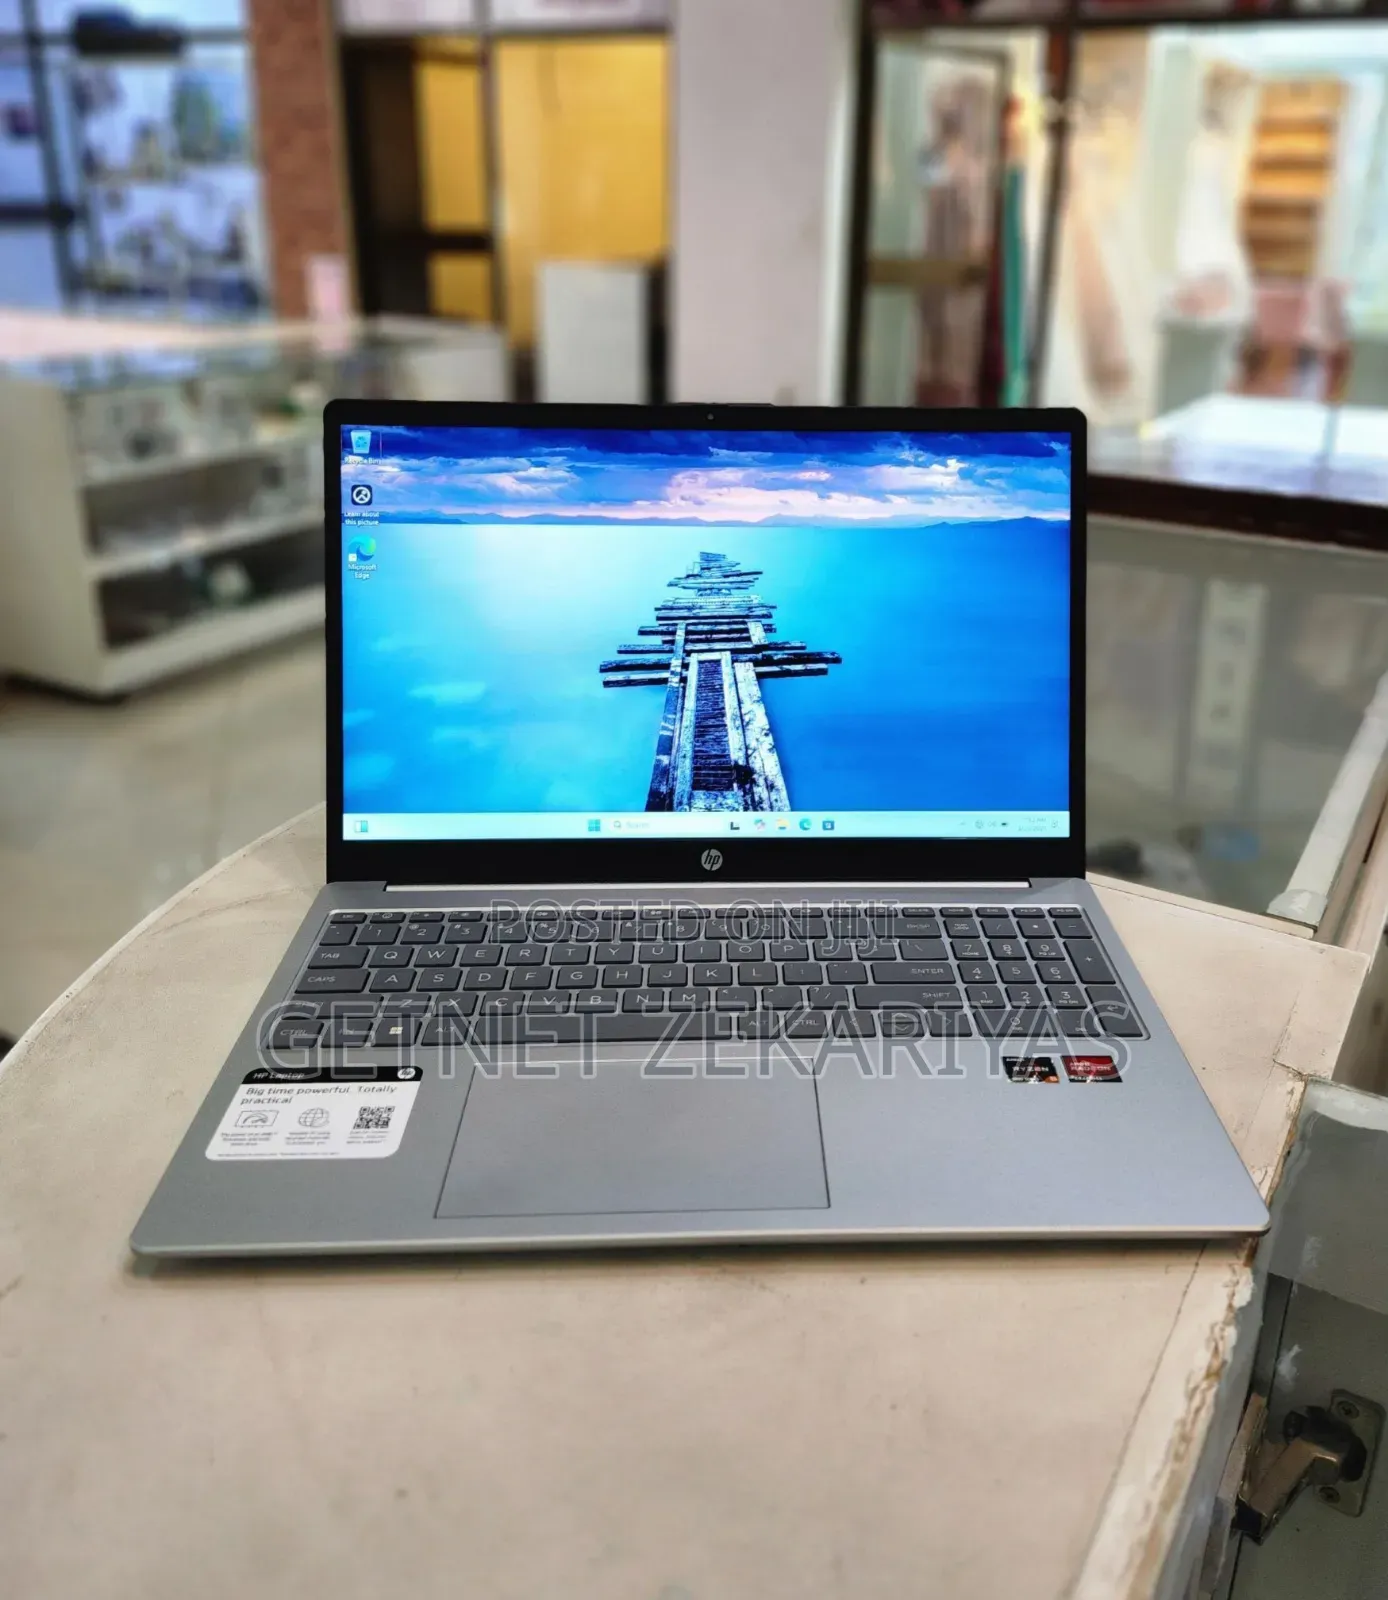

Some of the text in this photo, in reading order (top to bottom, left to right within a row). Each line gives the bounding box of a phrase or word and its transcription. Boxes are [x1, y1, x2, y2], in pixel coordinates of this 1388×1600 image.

[358, 519, 379, 527] picture
[348, 563, 377, 571] Microsoft
[354, 572, 370, 580] Edge
[701, 849, 723, 871] hp
[416, 928, 427, 936] 2
[383, 951, 398, 959] Q
[427, 950, 446, 959] W
[474, 950, 486, 958] E
[519, 949, 531, 957] R
[565, 948, 576, 956] T
[652, 947, 664, 955] U
[616, 970, 628, 979] H
[662, 970, 672, 978] J
[706, 969, 718, 977] K
[752, 968, 762, 976] L
[1012, 967, 1021, 975] 5
[1050, 967, 1060, 975] 6
[384, 974, 398, 983] A
[433, 973, 445, 982] S
[478, 973, 492, 982] D
[525, 972, 537, 981] F
[570, 971, 583, 980] G
[636, 994, 649, 1003] N
[682, 993, 696, 1002] M
[982, 991, 988, 999] 1
[1020, 991, 1030, 999] 2
[1061, 991, 1071, 999] 3
[400, 998, 413, 1008] Z
[448, 998, 460, 1007] X
[495, 997, 508, 1007] C
[543, 996, 556, 1005] V
[590, 995, 602, 1004] B
[397, 1068, 415, 1079] hp
[246, 1087, 265, 1096] Big
[267, 1087, 294, 1095] time
[357, 1085, 398, 1094] Totally
